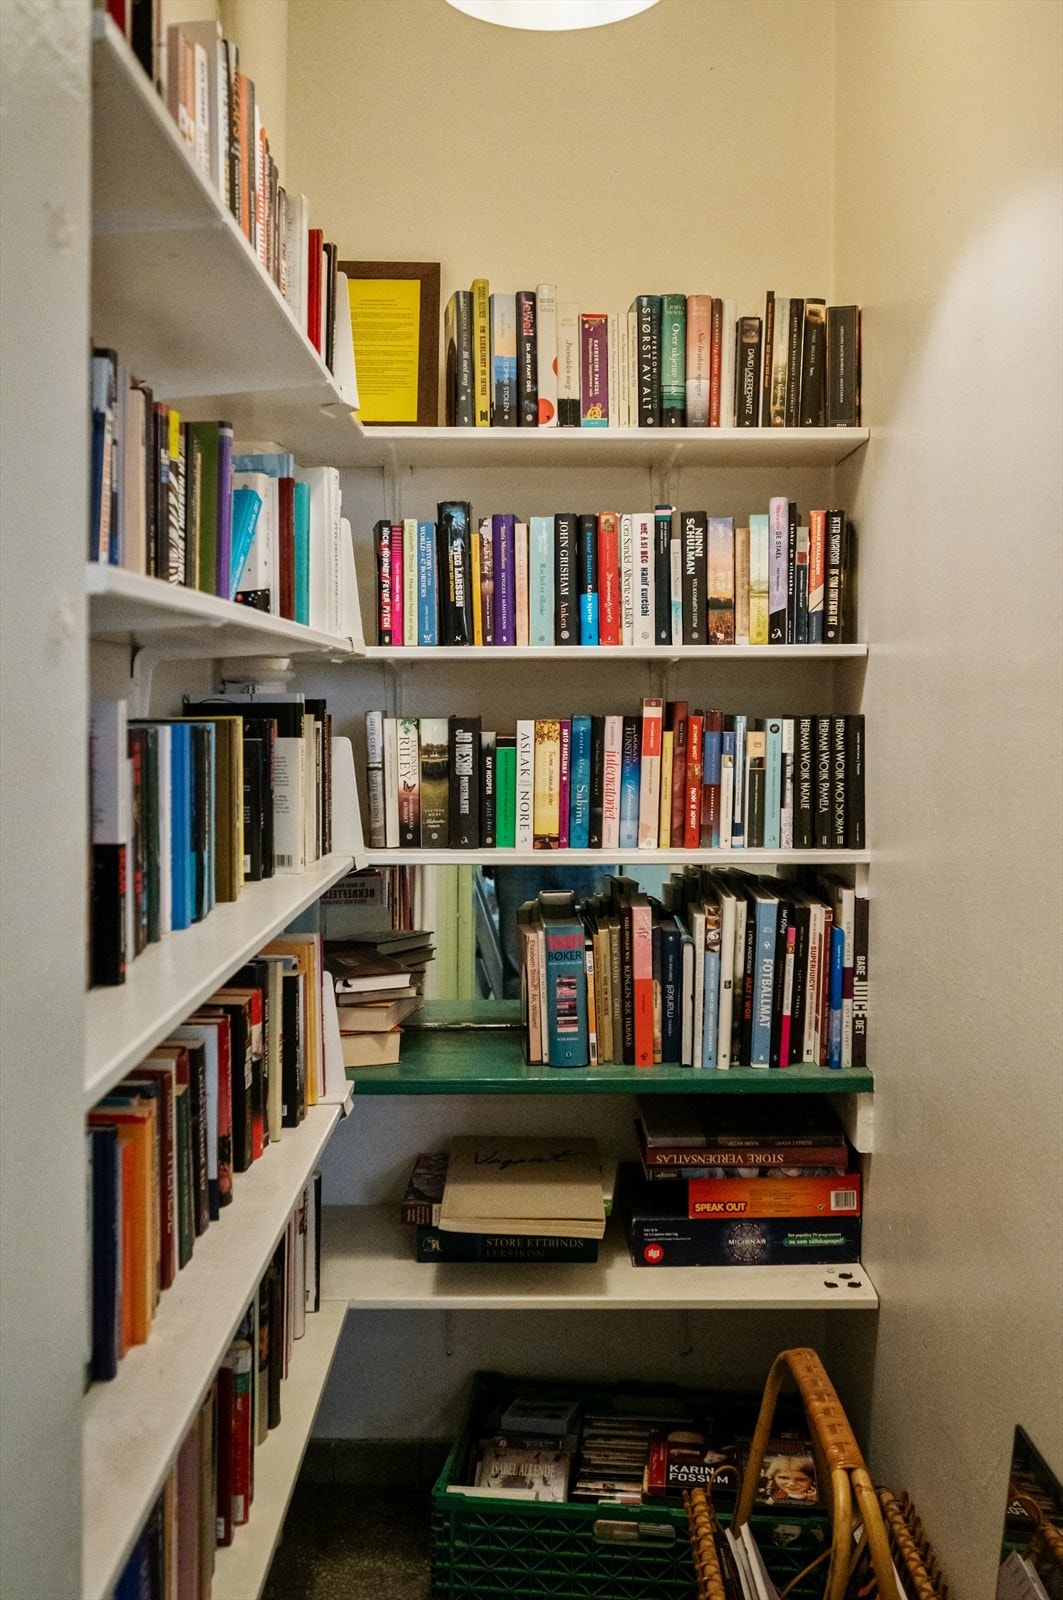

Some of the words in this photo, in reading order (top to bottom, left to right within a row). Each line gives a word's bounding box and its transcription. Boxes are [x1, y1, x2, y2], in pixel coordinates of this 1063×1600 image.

[522, 300, 534, 336] Jewell
[642, 307, 651, 358] STØRST
[672, 323, 680, 346] Over
[526, 342, 531, 352] DA
[643, 364, 651, 382] AV
[670, 347, 680, 378] ukjente
[460, 373, 469, 386] meg
[672, 380, 680, 396] hav
[745, 368, 754, 415] LAGERCRANTZ
[643, 386, 651, 410] ALT
[382, 527, 390, 545] NICK
[559, 520, 569, 547] JOHN
[623, 518, 631, 537] Cora
[776, 531, 782, 539] DE
[831, 516, 841, 535] PETER
[453, 539, 463, 566] STIEG
[623, 538, 632, 564] Sandel
[686, 518, 696, 575] SCHULMAN
[694, 527, 704, 557] NINNI
[789, 549, 794, 558] om
[830, 535, 840, 565] SWANSON
[382, 548, 390, 578] HORNBY
[420, 557, 426, 565] 47
[481, 560, 490, 574] Key
[560, 549, 569, 595] GRISHAM
[540, 563, 548, 586] Rachel
[623, 567, 632, 595] Alberte
[640, 567, 650, 587] Hanif
[382, 580, 391, 603] FEVER
[454, 567, 464, 608] LARSSON
[604, 571, 614, 623] Drømmehjerte
[539, 595, 547, 616] tilbake
[621, 595, 630, 606] og
[640, 588, 650, 617] Kureishi
[383, 605, 391, 628] PITCH
[560, 600, 569, 629] Anken
[586, 602, 594, 624] hjerter
[623, 604, 632, 628] Jakob
[407, 624, 415, 640] mulig
[456, 729, 472, 743] JO
[800, 719, 810, 750] HERMAN
[818, 720, 830, 751] HERMAN
[835, 719, 845, 750] HERMAN
[400, 737, 411, 780] RILEY
[455, 744, 473, 776] NESBØ
[520, 732, 530, 776] ASLAK
[800, 751, 810, 780] WOUK
[834, 752, 844, 780] WOUK
[819, 752, 830, 781] WOUK
[460, 776, 469, 814] PANSERHJERTE
[604, 750, 620, 821] juleoratoriet
[800, 782, 810, 810] NATALIE
[818, 782, 829, 813] PAMELA
[835, 781, 844, 802] MOT
[520, 790, 530, 831] NORE
[575, 784, 588, 825] Sabina
[834, 803, 844, 835] STORM
[547, 934, 584, 951] 1001
[548, 950, 582, 962] BØKER
[808, 945, 817, 991] SUPERJUICY!
[856, 956, 866, 976] BARE
[624, 965, 632, 998] KONGEN
[759, 958, 773, 1029] FOTBALLMAT
[530, 993, 538, 1004] Åh,
[624, 1000, 632, 1015] SER
[665, 984, 675, 1018] mankell
[852, 976, 868, 1018] JUICE
[744, 1000, 752, 1020] WOK
[855, 1020, 865, 1035] DET
[656, 1154, 744, 1164] VERDENSATLAS
[748, 1153, 784, 1164] STORE
[694, 1202, 724, 1212] SPEAK
[726, 1202, 747, 1212] OUT
[486, 1238, 523, 1248] STORE
[527, 1237, 584, 1248] ETTBINDS
[486, 1249, 544, 1258] LEKSIKON
[648, 1248, 660, 1259] alga
[490, 1462, 516, 1476] ISABEL
[518, 1463, 555, 1478] ALLENDE
[669, 1464, 714, 1475] KARIN
